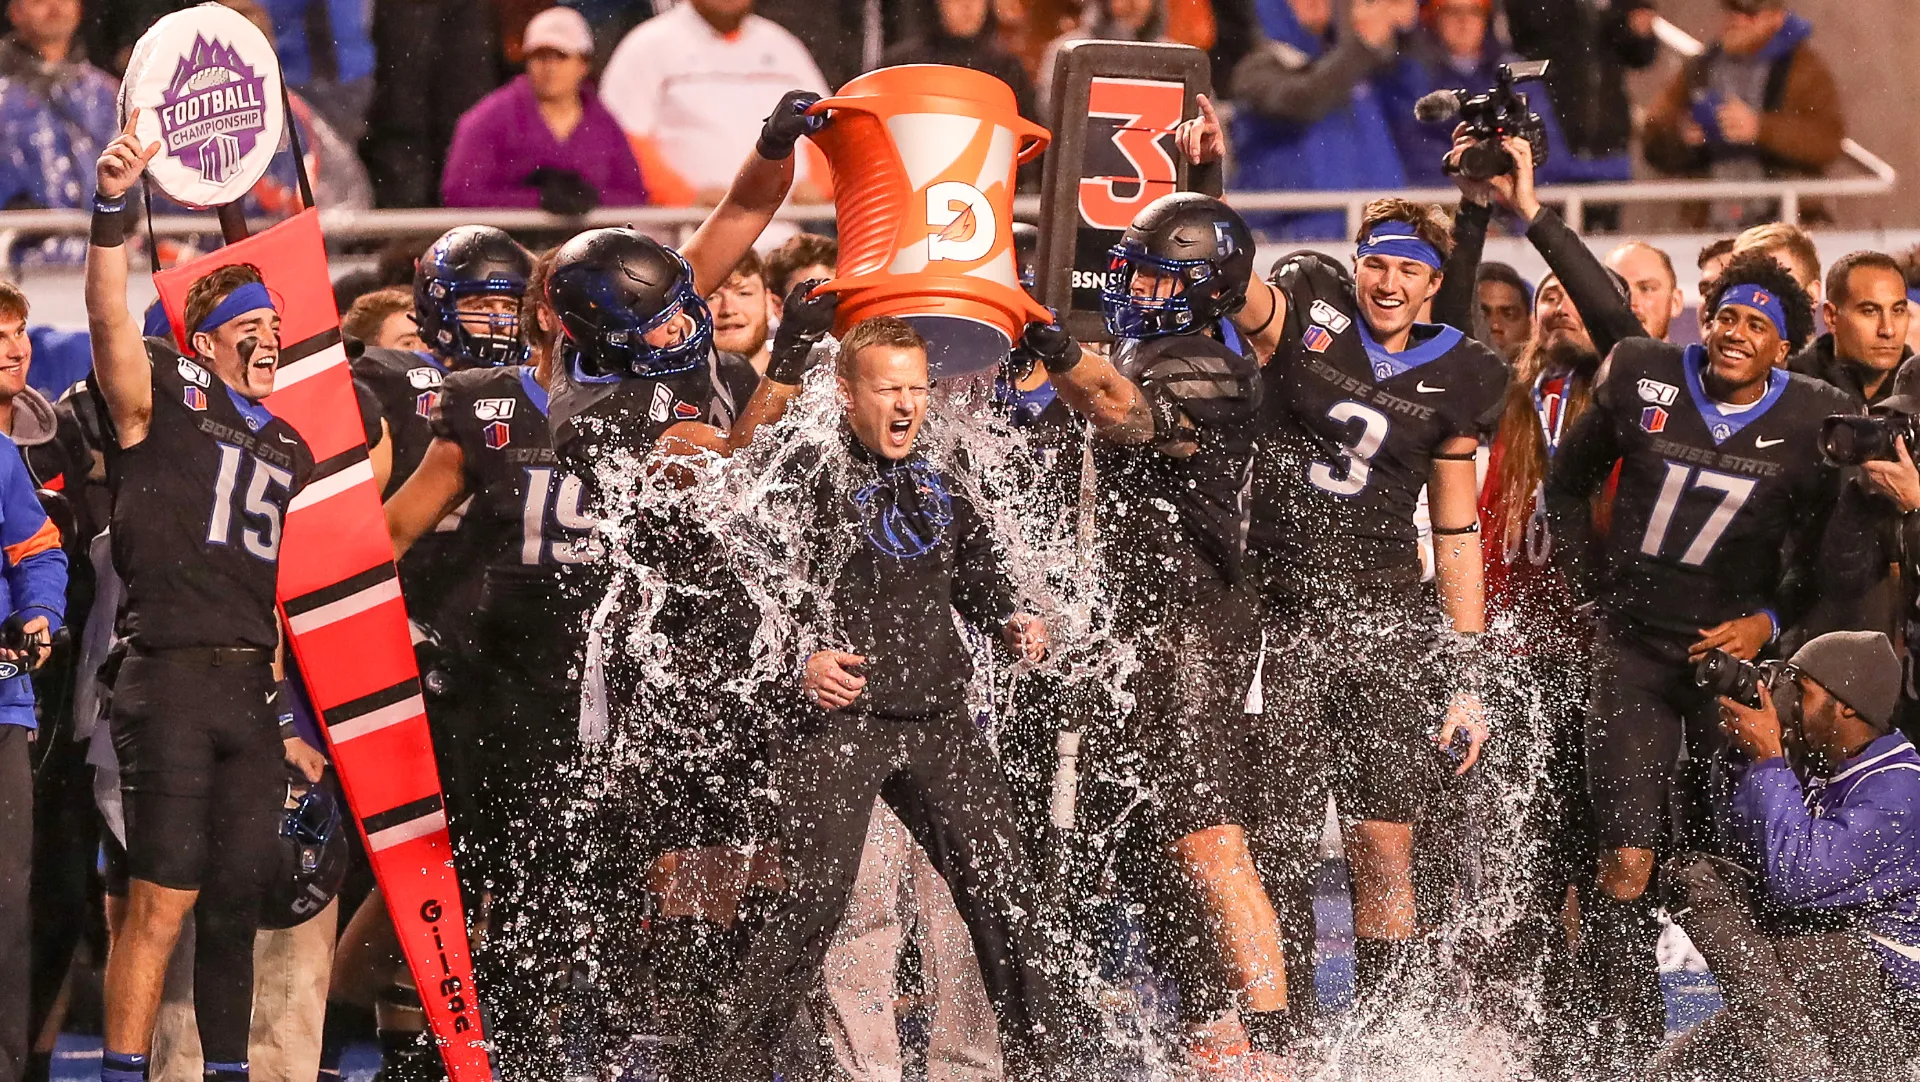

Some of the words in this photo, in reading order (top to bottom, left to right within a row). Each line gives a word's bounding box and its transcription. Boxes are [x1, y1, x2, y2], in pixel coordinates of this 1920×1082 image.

[162, 83, 261, 132] FOOTBALL
[172, 112, 258, 146] CHAMPIONSHIP
[1078, 77, 1184, 230] 3
[925, 180, 997, 262] G
[1071, 270, 1107, 289] BSN
[1752, 291, 1770, 305] 17
[1309, 299, 1352, 335] 150
[177, 356, 211, 389] 150
[407, 367, 443, 389] 150
[1309, 360, 1373, 398] BOISE
[1373, 390, 1436, 421] STATE
[1636, 378, 1680, 406] 150
[473, 398, 516, 420] 150
[200, 417, 256, 451] BOISE
[257, 442, 292, 468] STAT
[506, 447, 559, 462] BOIS
[1308, 399, 1390, 498] 3
[1651, 438, 1717, 465] BOISE
[1719, 453, 1781, 476] STATE
[206, 441, 294, 563] 15
[521, 466, 606, 565] 19
[1640, 459, 1759, 566] 17
[420, 899, 470, 1035] Gilman
